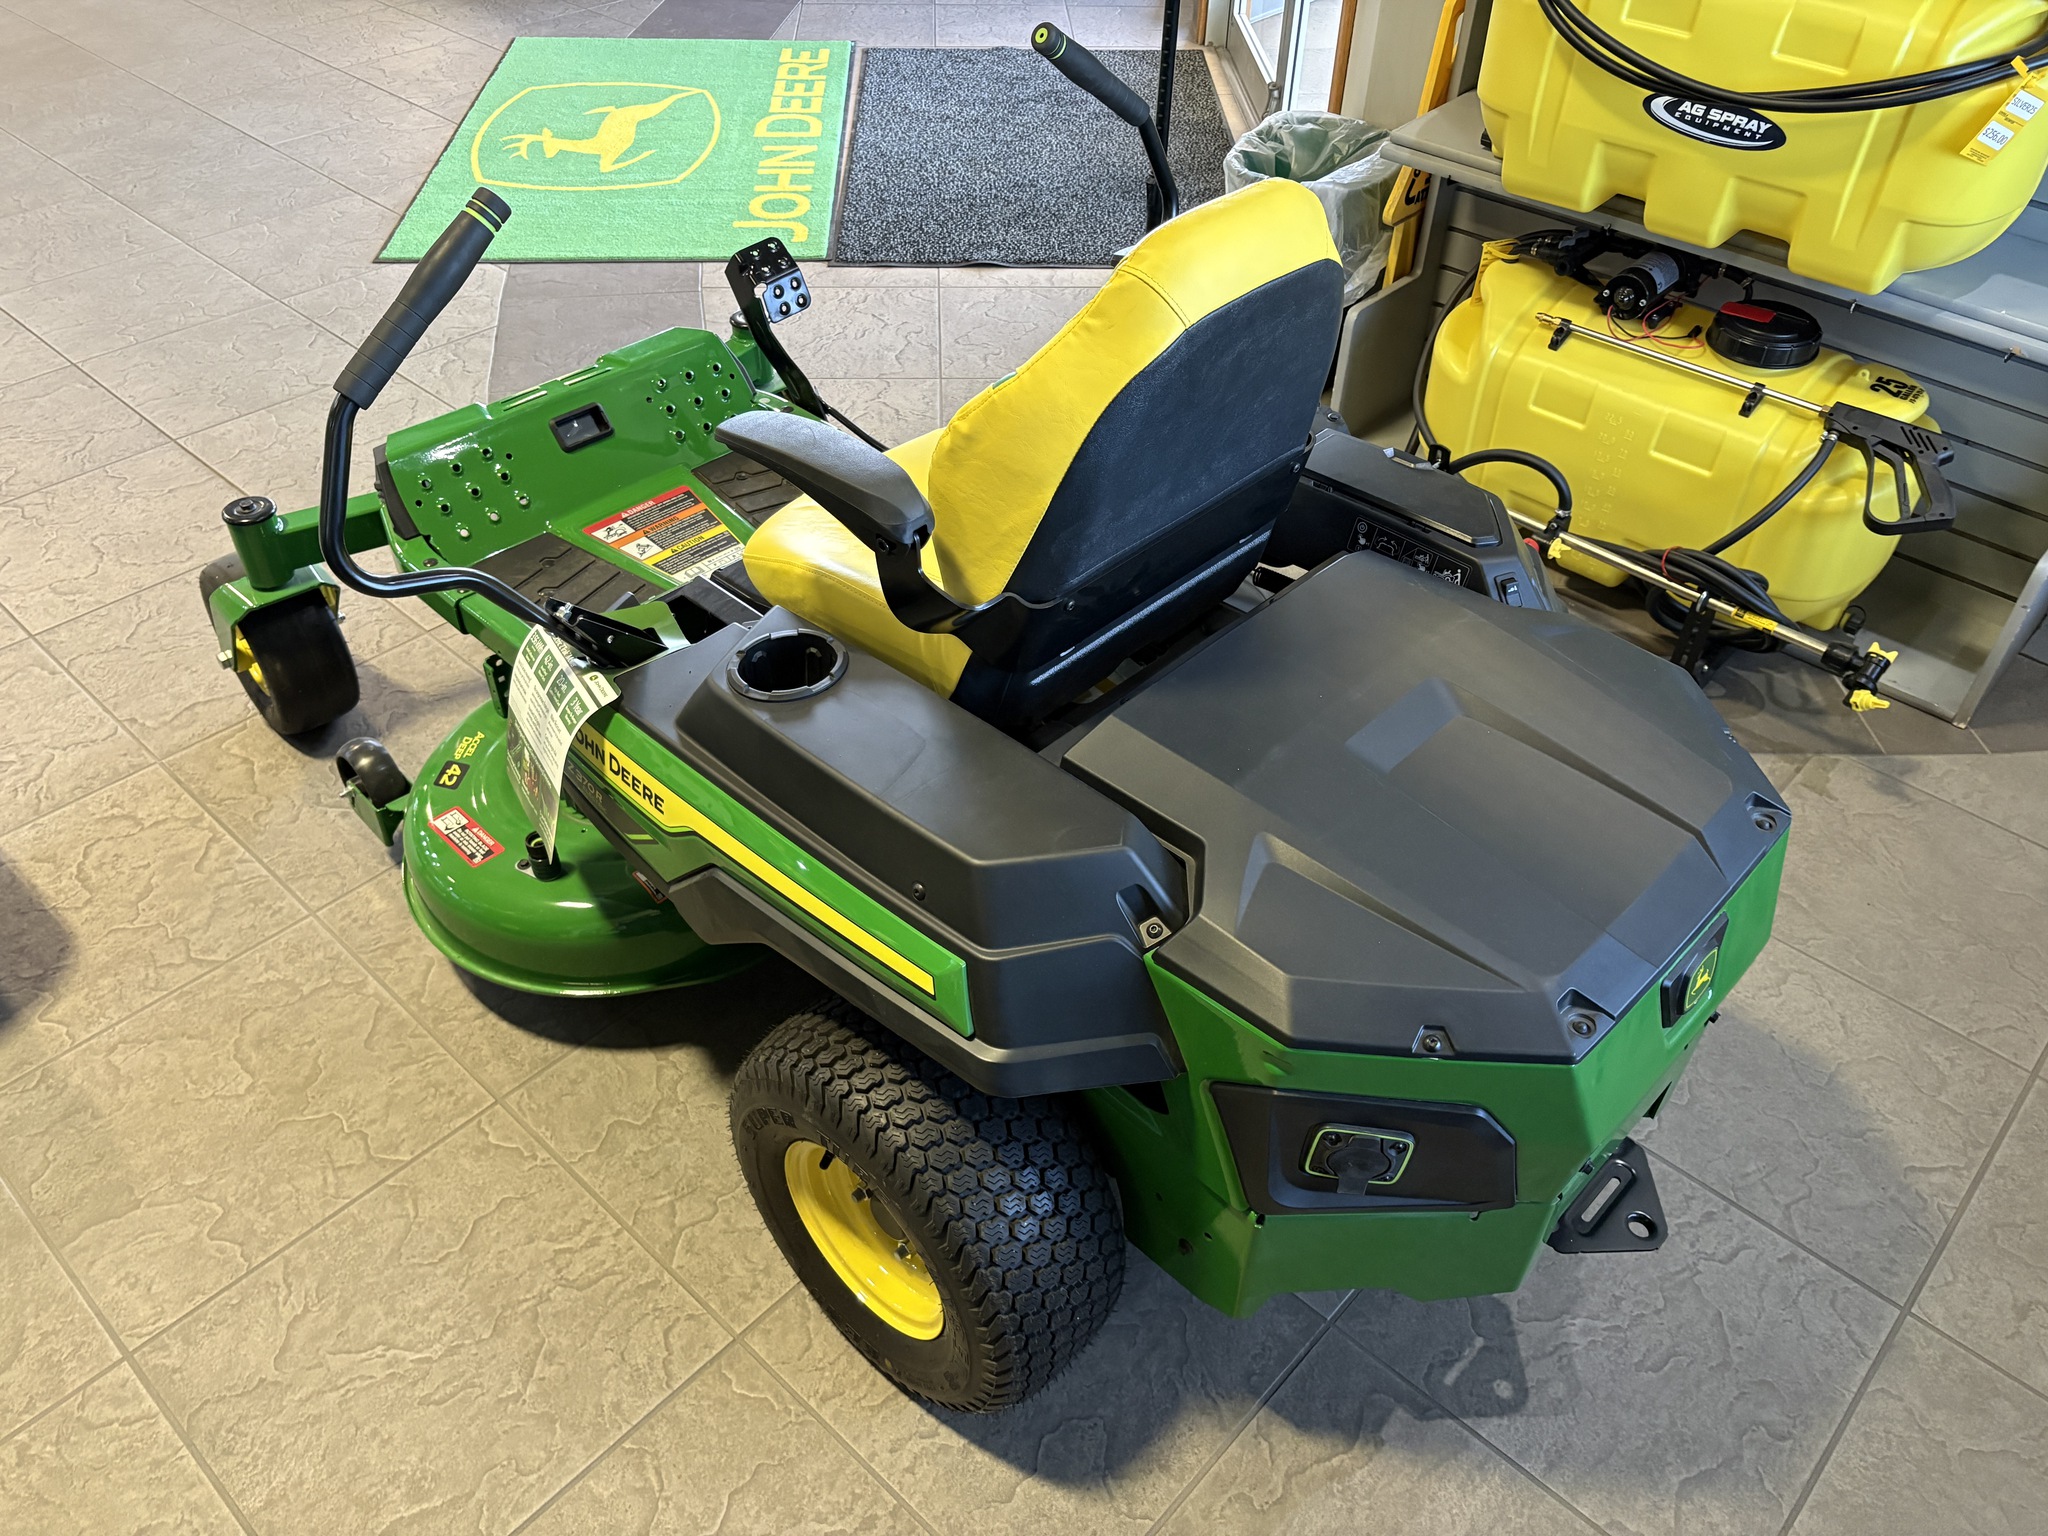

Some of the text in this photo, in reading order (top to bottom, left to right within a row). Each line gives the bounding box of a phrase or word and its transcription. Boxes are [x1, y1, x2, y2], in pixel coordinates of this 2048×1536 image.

[1675, 112, 1763, 140] EQUIPMENT
[1678, 101, 1773, 134] AG SPRAY
[732, 48, 831, 242] JOHN DEERE
[1982, 127, 2009, 145] $256.00
[1870, 376, 1908, 398] 25
[627, 500, 656, 515] DANGER
[649, 515, 680, 532] WARNING
[676, 535, 705, 550] CAUTION
[454, 736, 473, 760] DEEP
[463, 731, 486, 758] ACCEL
[439, 764, 462, 786] 42
[574, 729, 605, 766] OHN
[609, 752, 665, 815] DEERE
[476, 829, 495, 846] DANGER
[742, 1106, 798, 1141] SUPER
